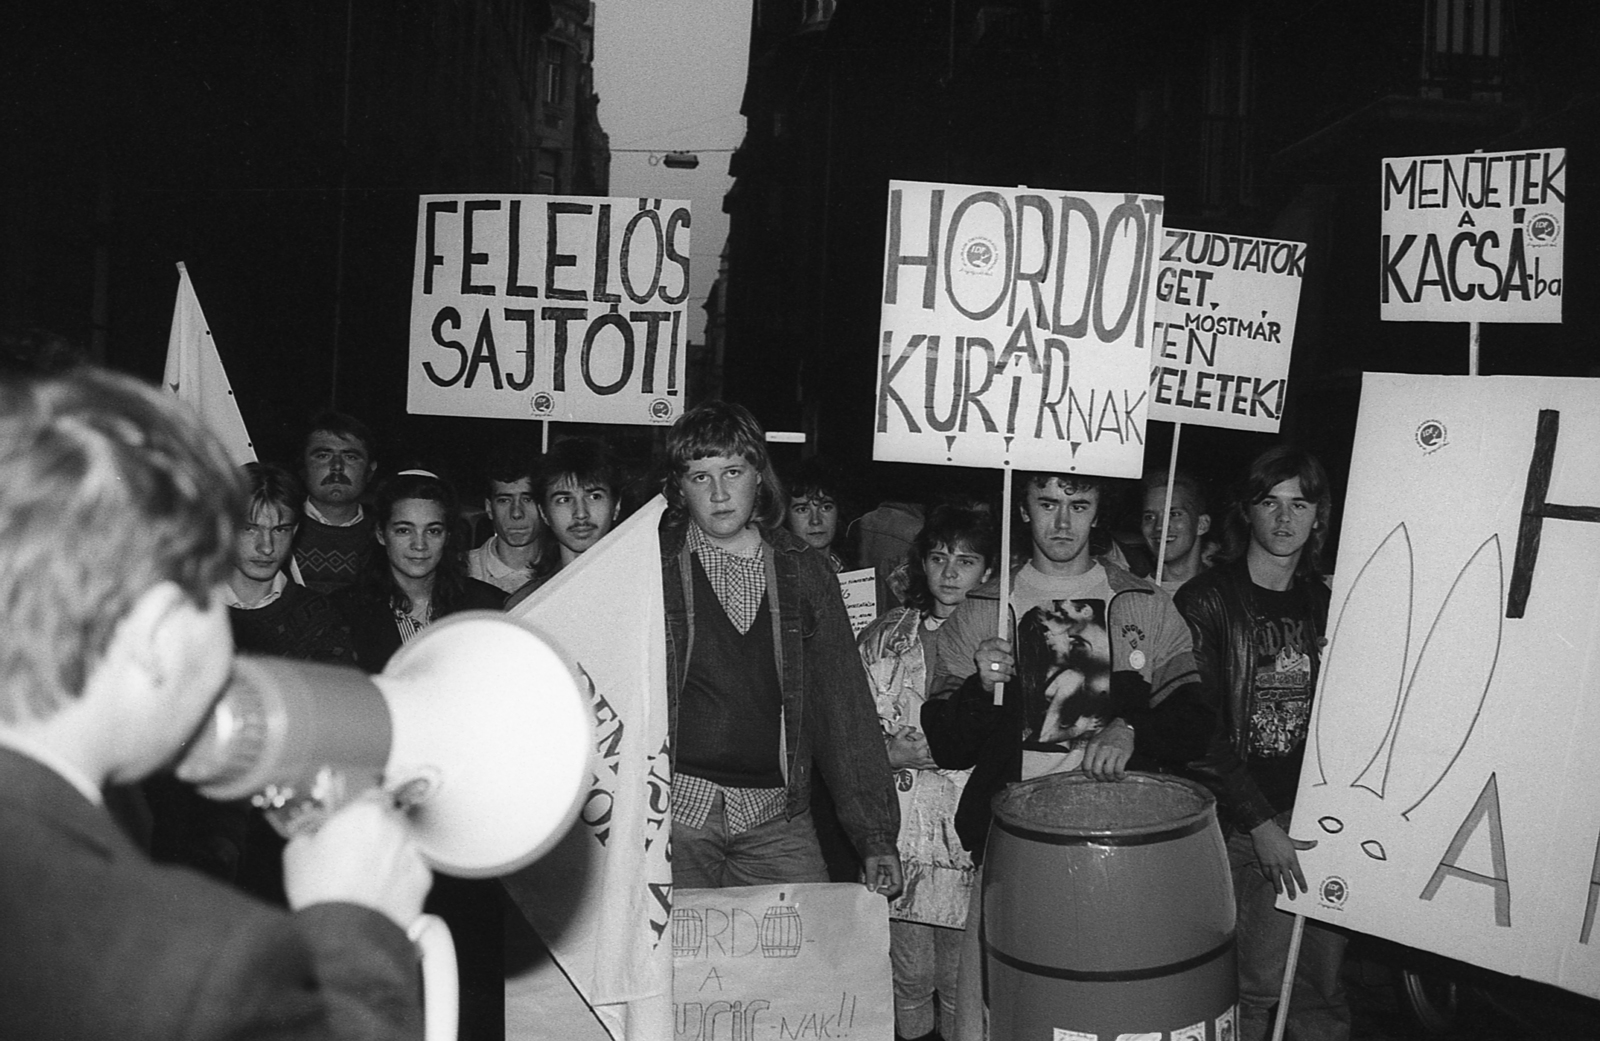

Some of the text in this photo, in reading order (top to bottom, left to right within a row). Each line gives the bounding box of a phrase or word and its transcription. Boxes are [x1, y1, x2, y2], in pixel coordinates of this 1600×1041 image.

[1384, 152, 1566, 211] MENJETEK
[1457, 210, 1476, 228] A
[884, 188, 1164, 348] HORDÓT
[421, 303, 682, 396] SAJTÓT!
[993, 307, 1043, 375] A
